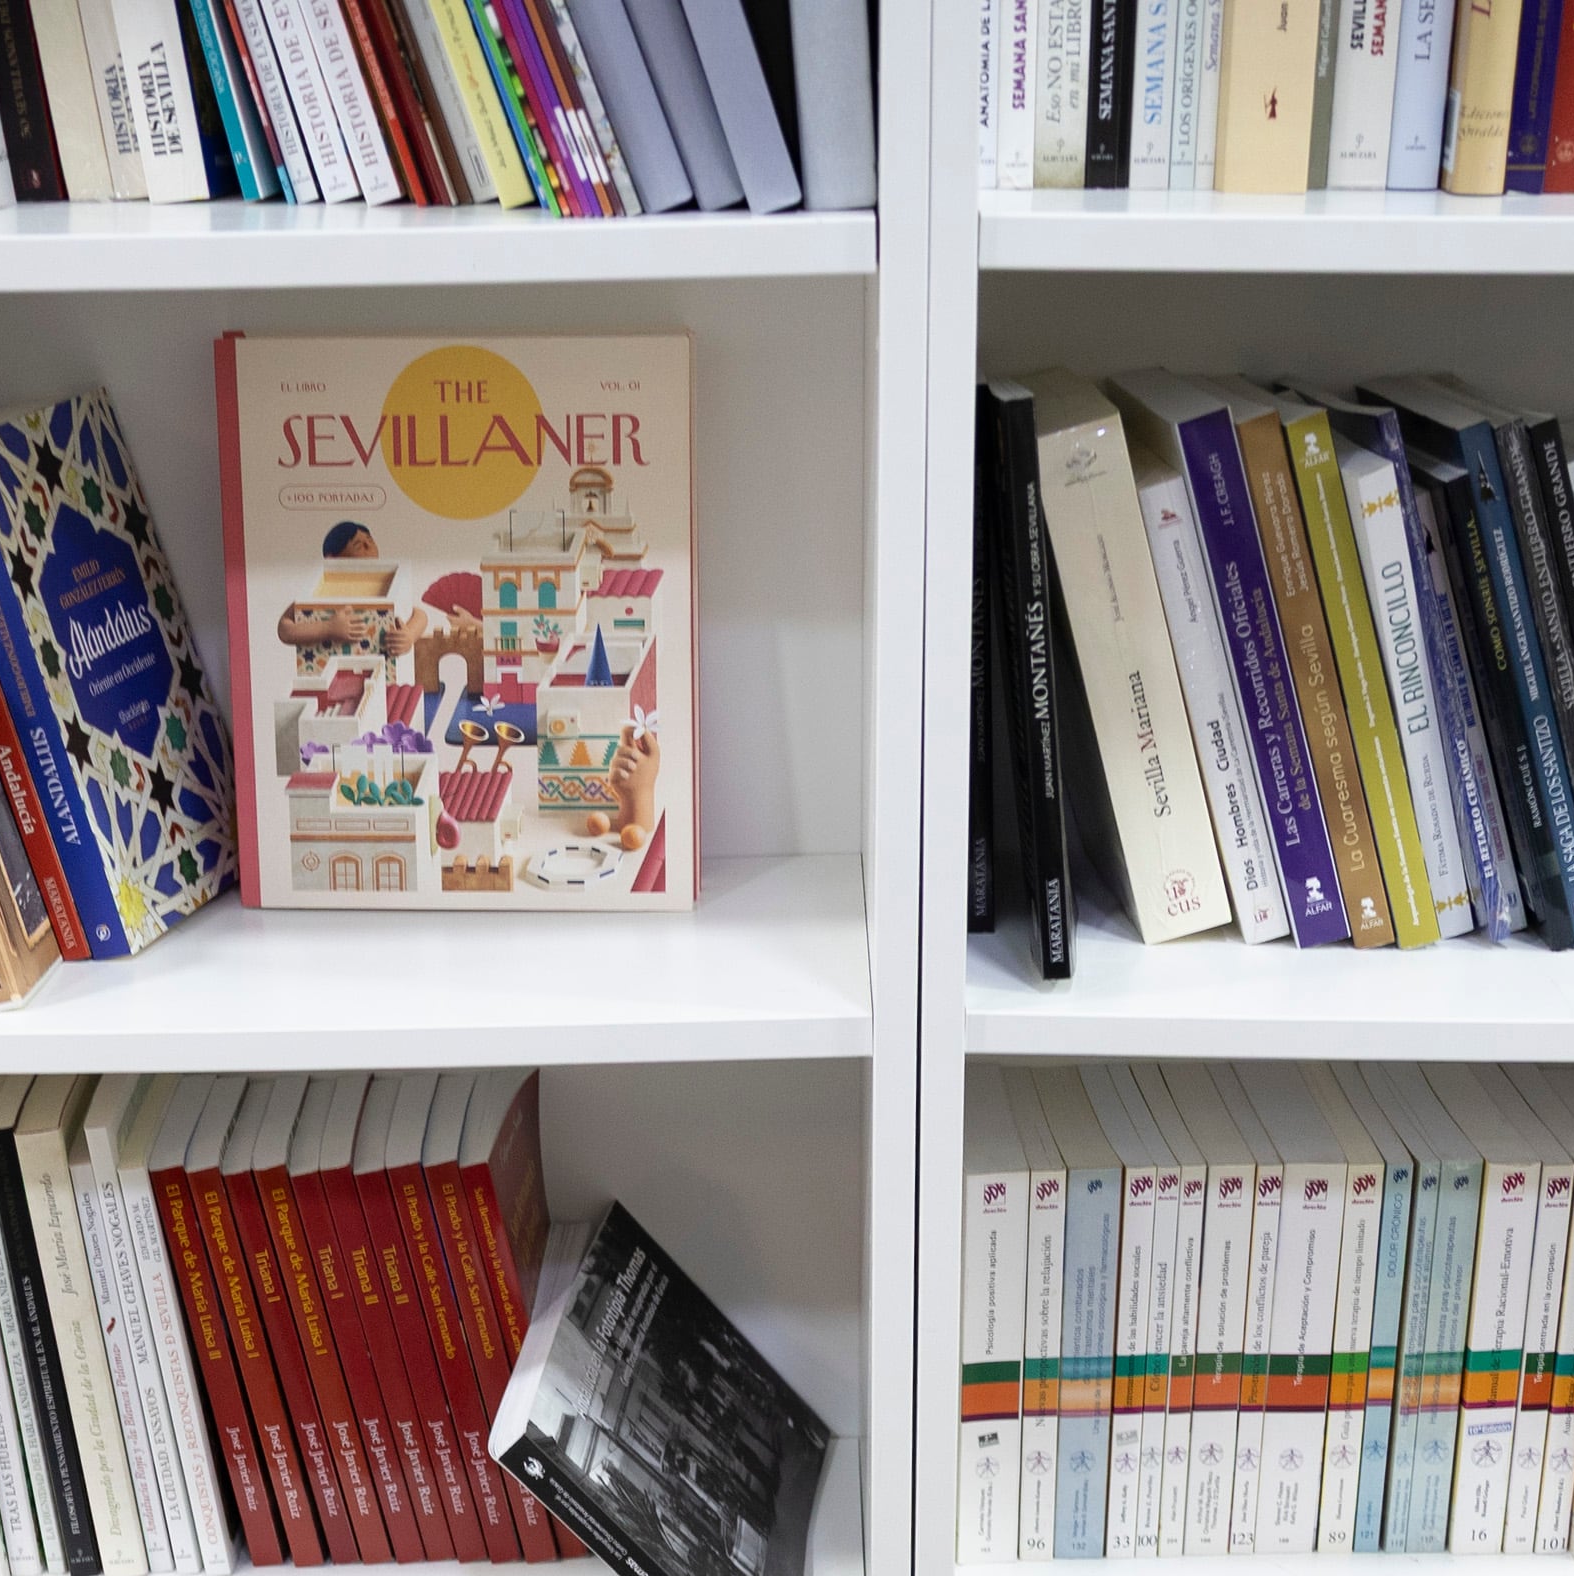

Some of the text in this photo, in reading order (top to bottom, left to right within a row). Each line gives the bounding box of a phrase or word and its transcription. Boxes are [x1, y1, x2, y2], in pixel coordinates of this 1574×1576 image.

[137, 60, 168, 157] HISTORIA
[149, 41, 184, 155] DE SEVILLA
[280, 381, 326, 393] EL LIBRO
[433, 380, 489, 403] THE
[277, 414, 650, 467] SEVILLANER
[1025, 601, 1051, 722] MONTAÑÉS
[1299, 624, 1324, 686] Sevilla
[1381, 560, 1429, 735] EL RINCONCILLO
[1128, 669, 1172, 818] Sevilla Mariana
[1314, 692, 1338, 748] según
[30, 727, 81, 846] ALANDALUS
[1329, 752, 1359, 846] Cuaresma
[1047, 876, 1065, 965] MARATANIA
[227, 1427, 257, 1512] José Javier Ruiz
